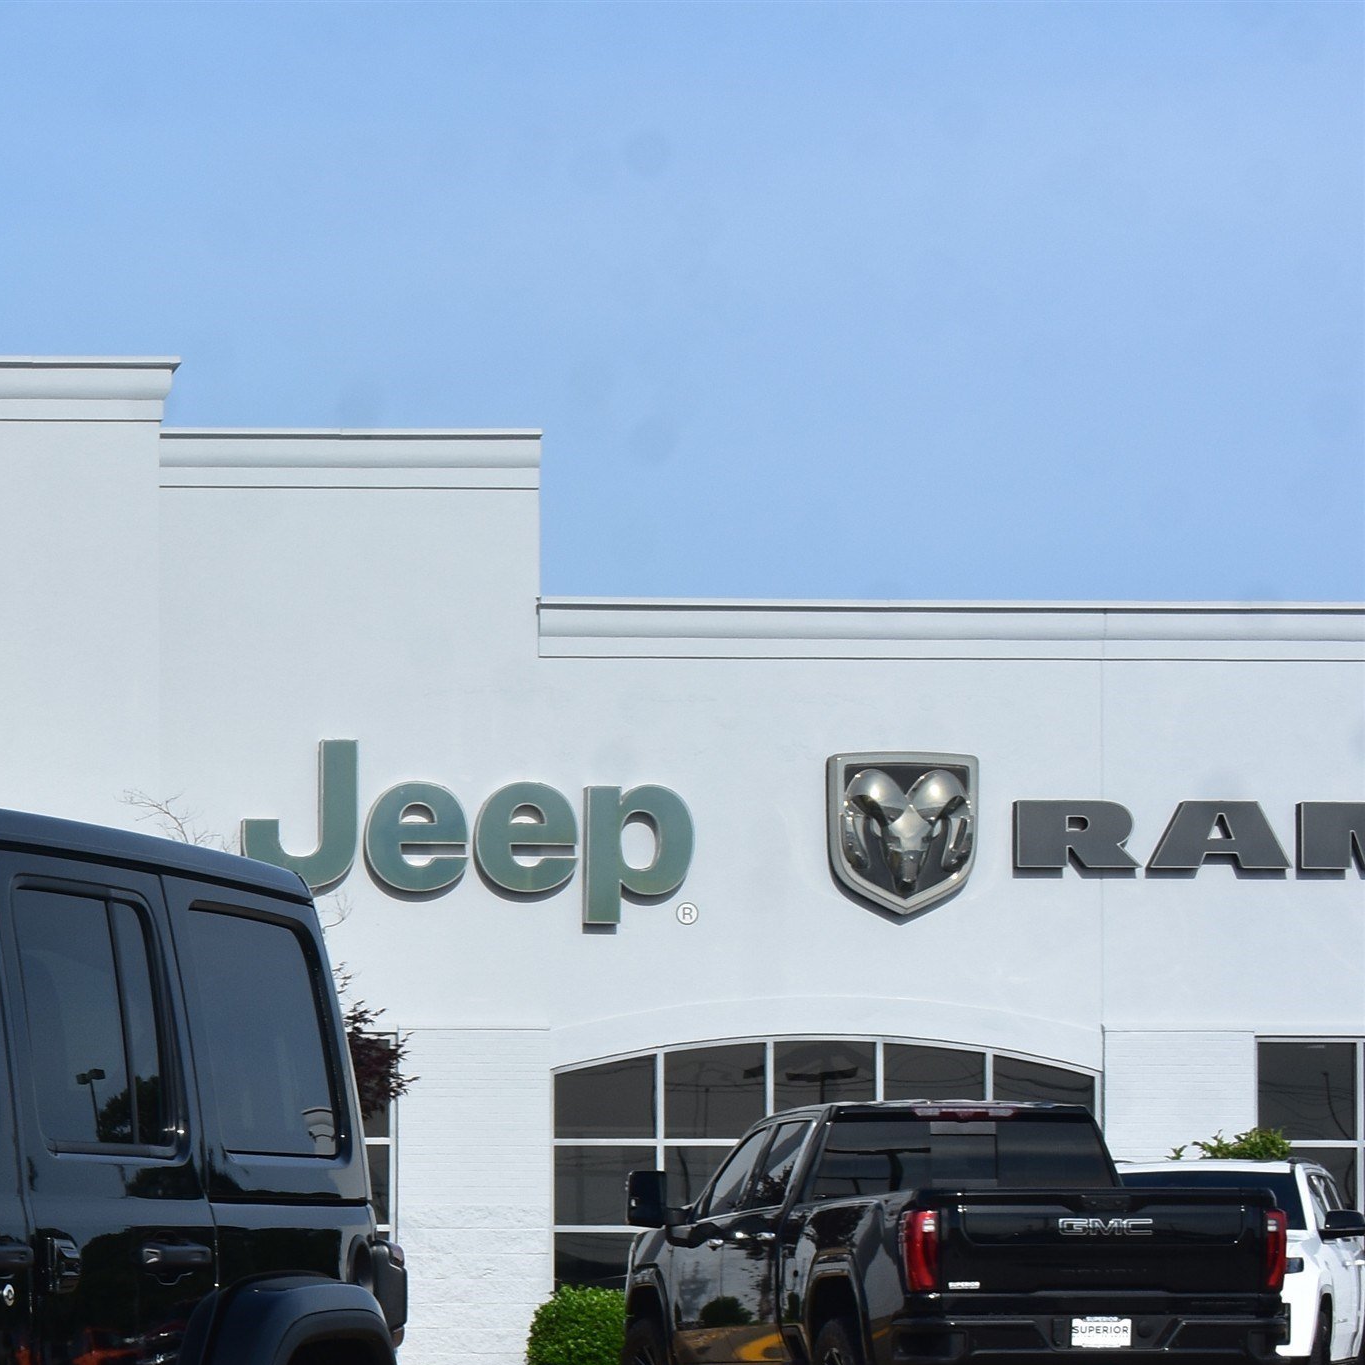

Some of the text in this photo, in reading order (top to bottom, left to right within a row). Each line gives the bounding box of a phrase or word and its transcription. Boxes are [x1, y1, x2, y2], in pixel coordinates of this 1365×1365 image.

[242, 738, 696, 924] Jeep
[1058, 1218, 1153, 1236] GMC
[1072, 1325, 1129, 1334] SUPERIOR
